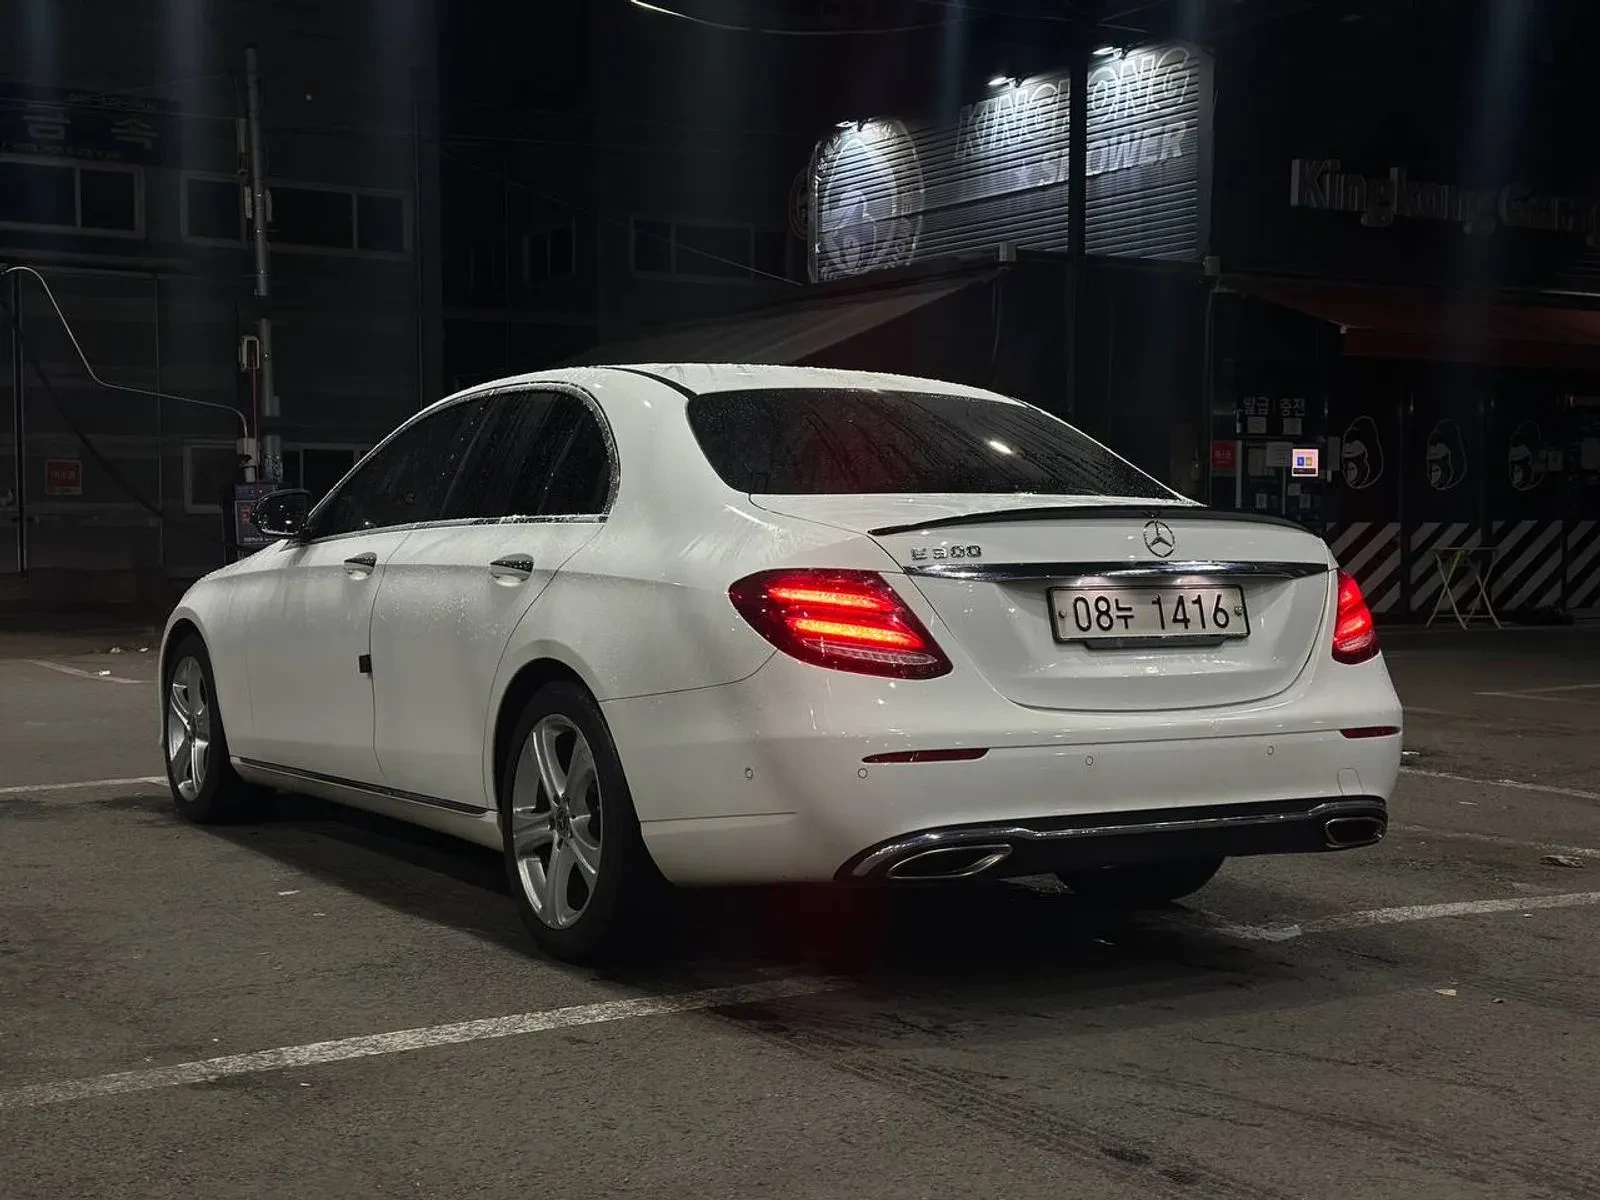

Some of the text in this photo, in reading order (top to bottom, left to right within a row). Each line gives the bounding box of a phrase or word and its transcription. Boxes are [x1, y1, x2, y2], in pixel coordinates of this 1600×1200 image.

[911, 545, 981, 561] E 300
[1072, 592, 1231, 632] 08누 1416
